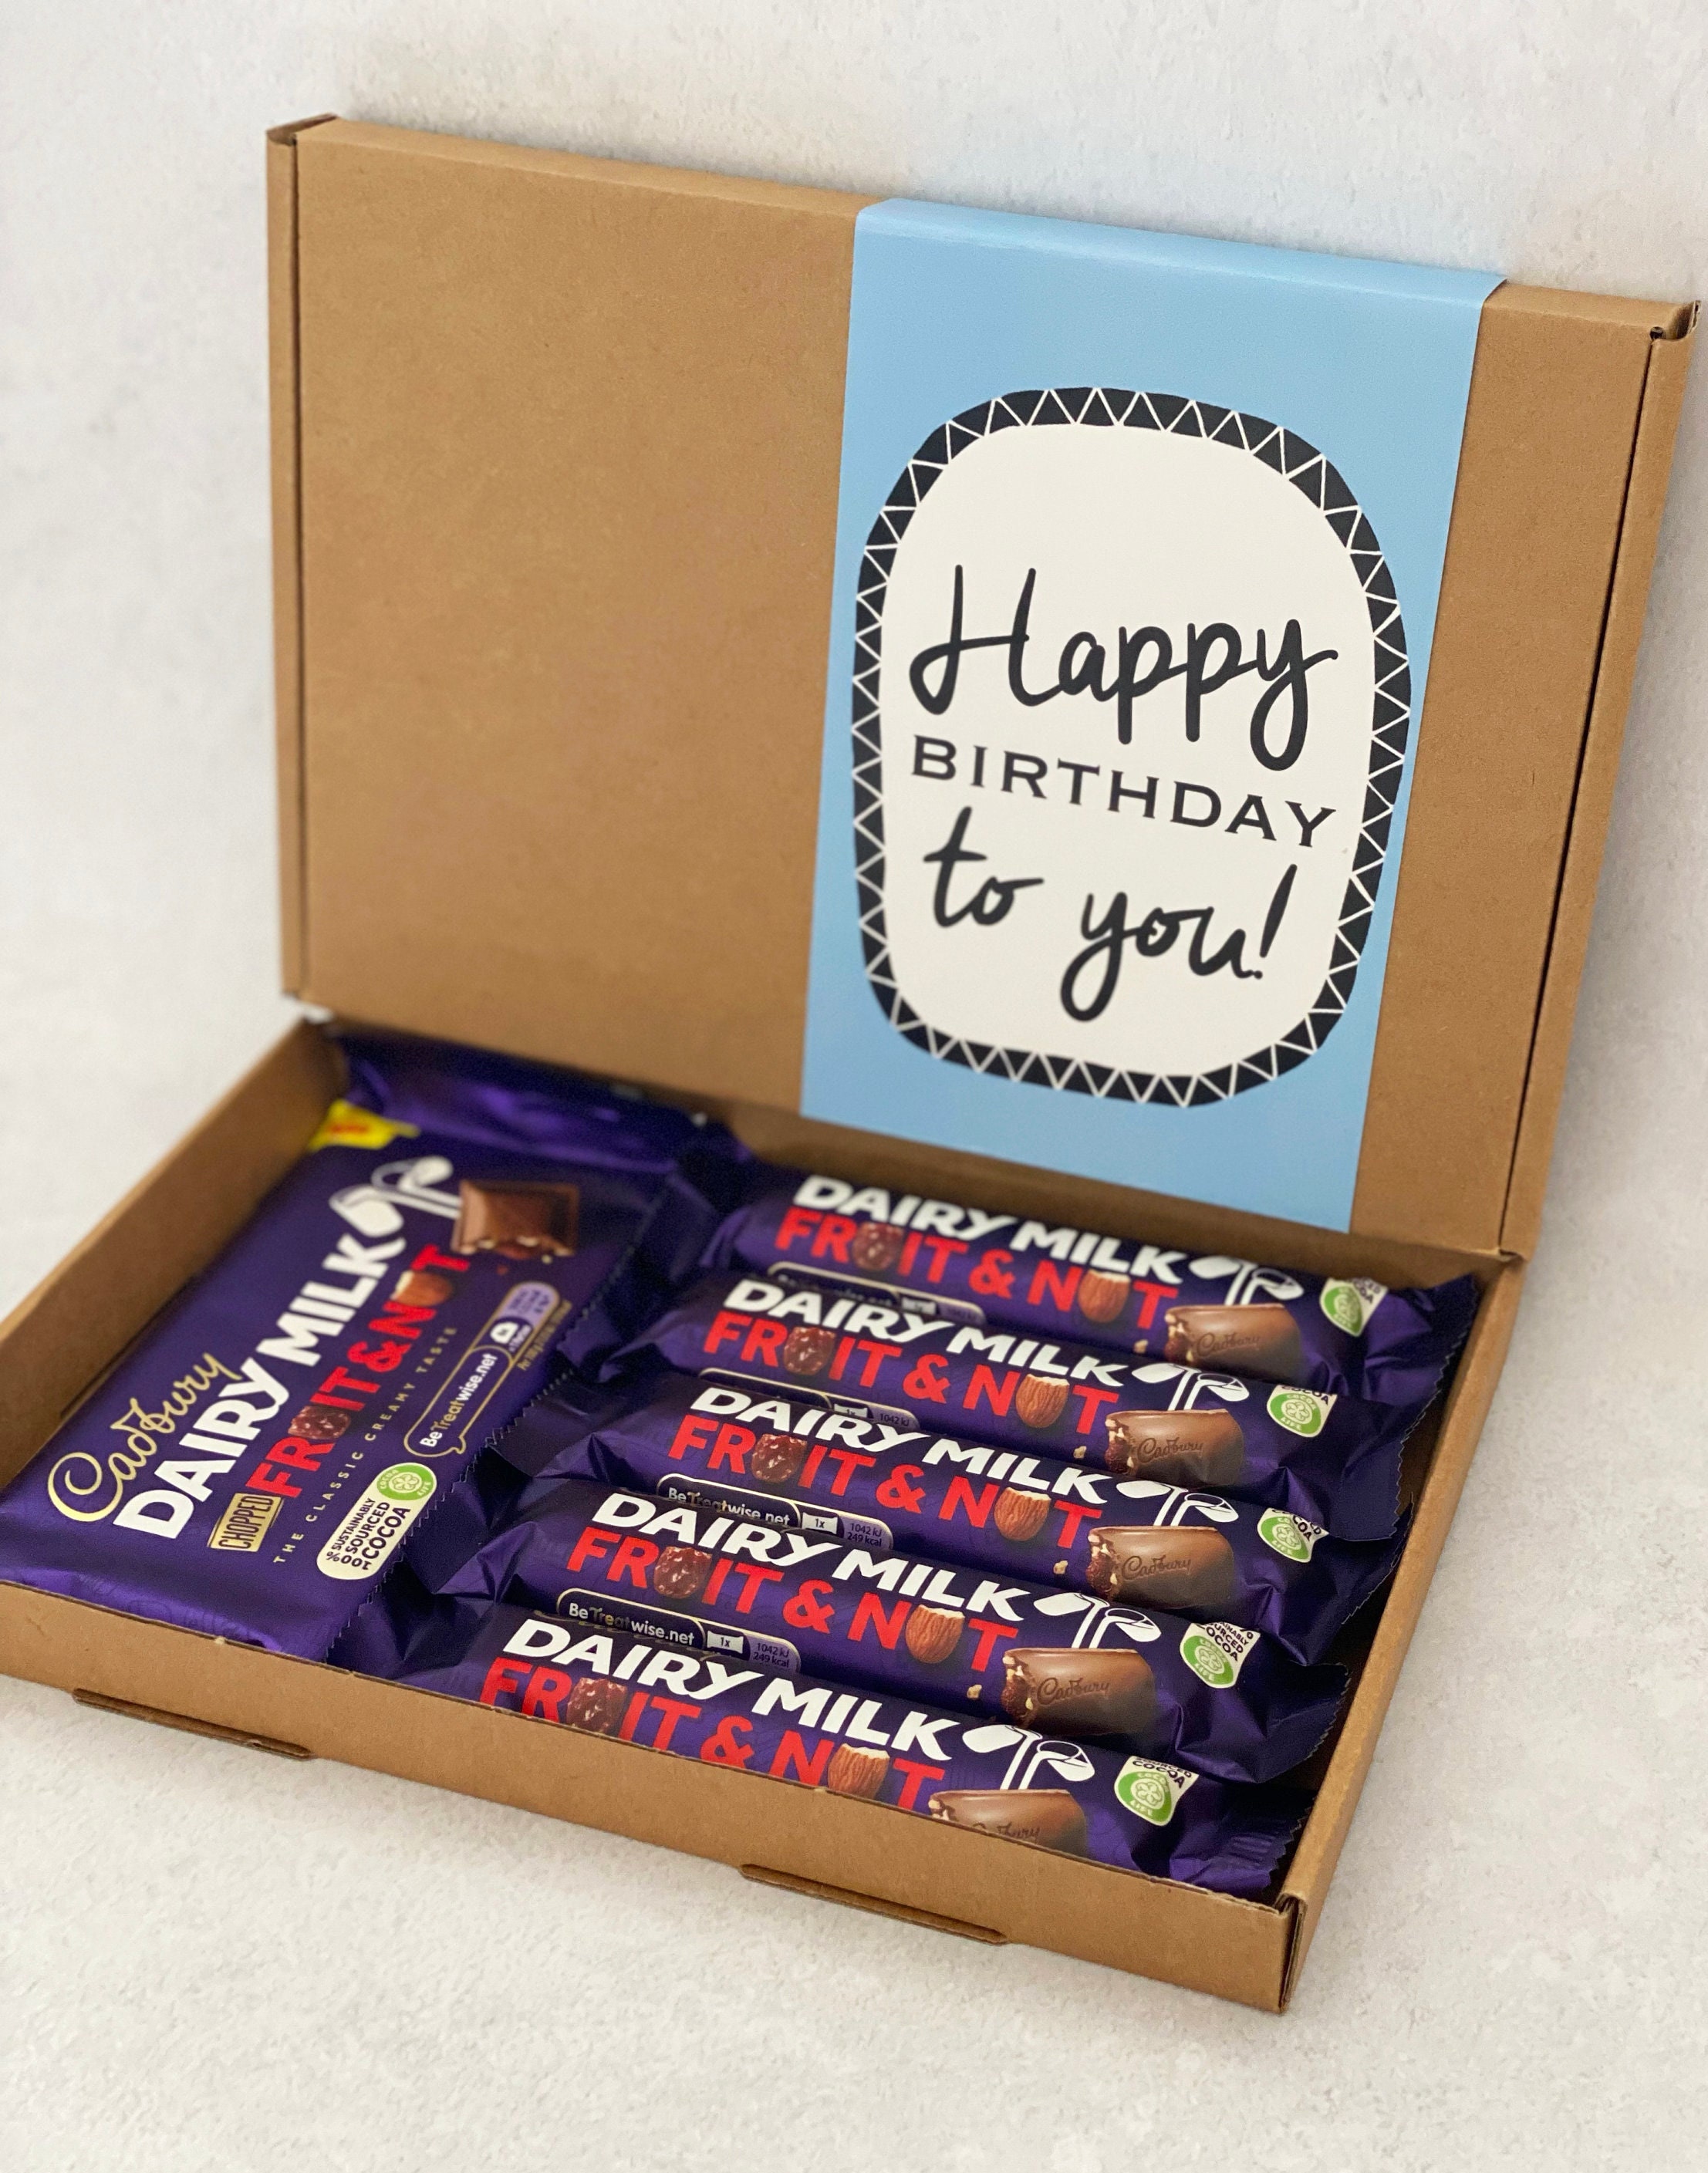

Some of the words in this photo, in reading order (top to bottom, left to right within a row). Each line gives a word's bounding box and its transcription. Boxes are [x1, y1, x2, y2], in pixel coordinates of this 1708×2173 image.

[909, 565, 1338, 771] Happy
[911, 734, 1336, 848] BIRTHDAY
[923, 806, 1045, 928] to
[1061, 863, 1298, 1022] you!
[775, 1206, 969, 1284] FRIT
[968, 1248, 1016, 1299] &
[1027, 1259, 1179, 1329] NT
[793, 1175, 1018, 1240] DAIRY
[1009, 1220, 1188, 1284] MILK
[368, 1244, 471, 1340] NT
[723, 1279, 955, 1343] DAIRY
[946, 1326, 1129, 1387] MILK
[113, 1357, 289, 1539] DAIRY
[256, 1233, 407, 1367] MILK
[347, 1341, 413, 1372] &
[704, 1311, 903, 1388] FRIT
[903, 1354, 951, 1404] &
[963, 1363, 1119, 1435] NT
[48, 1353, 243, 1522] Cadbury
[245, 1366, 381, 1498] FRIT
[273, 1532, 305, 1564] THE
[305, 1452, 364, 1523] CLASSIC
[364, 1382, 415, 1442] CREAMY
[416, 1327, 457, 1373] TASTE
[690, 1387, 932, 1453] DAIRY
[921, 1438, 1114, 1504] MILK
[1137, 1436, 1203, 1463] Cadbury
[218, 1495, 275, 1550] CHOPPED
[332, 1497, 376, 1550] SUSTAINABLY
[345, 1502, 390, 1554] SOURCED
[668, 1415, 876, 1497] FRIT
[876, 1463, 926, 1514] &
[938, 1475, 1103, 1549] NT
[815, 1517, 825, 1529] 1x
[849, 1522, 872, 1535] 1042
[326, 1551, 373, 1571] 100%
[362, 1507, 411, 1560] COCOA
[592, 1493, 843, 1567] DAIRY
[832, 1548, 1031, 1621] MILK
[846, 1531, 864, 1542] 249
[865, 1533, 883, 1547] kcal
[1122, 1554, 1192, 1581] Cadbury
[566, 1527, 785, 1614] FRIT
[783, 1579, 835, 1634] &
[847, 1592, 1019, 1672] NT
[720, 1637, 731, 1648] 1x
[1210, 1623, 1244, 1653] URCED
[503, 1618, 765, 1700] DAIRY
[751, 1677, 961, 1761] MILK
[752, 1652, 771, 1663] 249
[771, 1655, 790, 1668] kcal
[757, 1642, 779, 1655] 1042
[1037, 1677, 1110, 1706] Cadbury
[480, 1657, 702, 1753] FRIT
[700, 1715, 754, 1769] &
[769, 1729, 946, 1810] NT
[1132, 1760, 1186, 1789] COCOA
